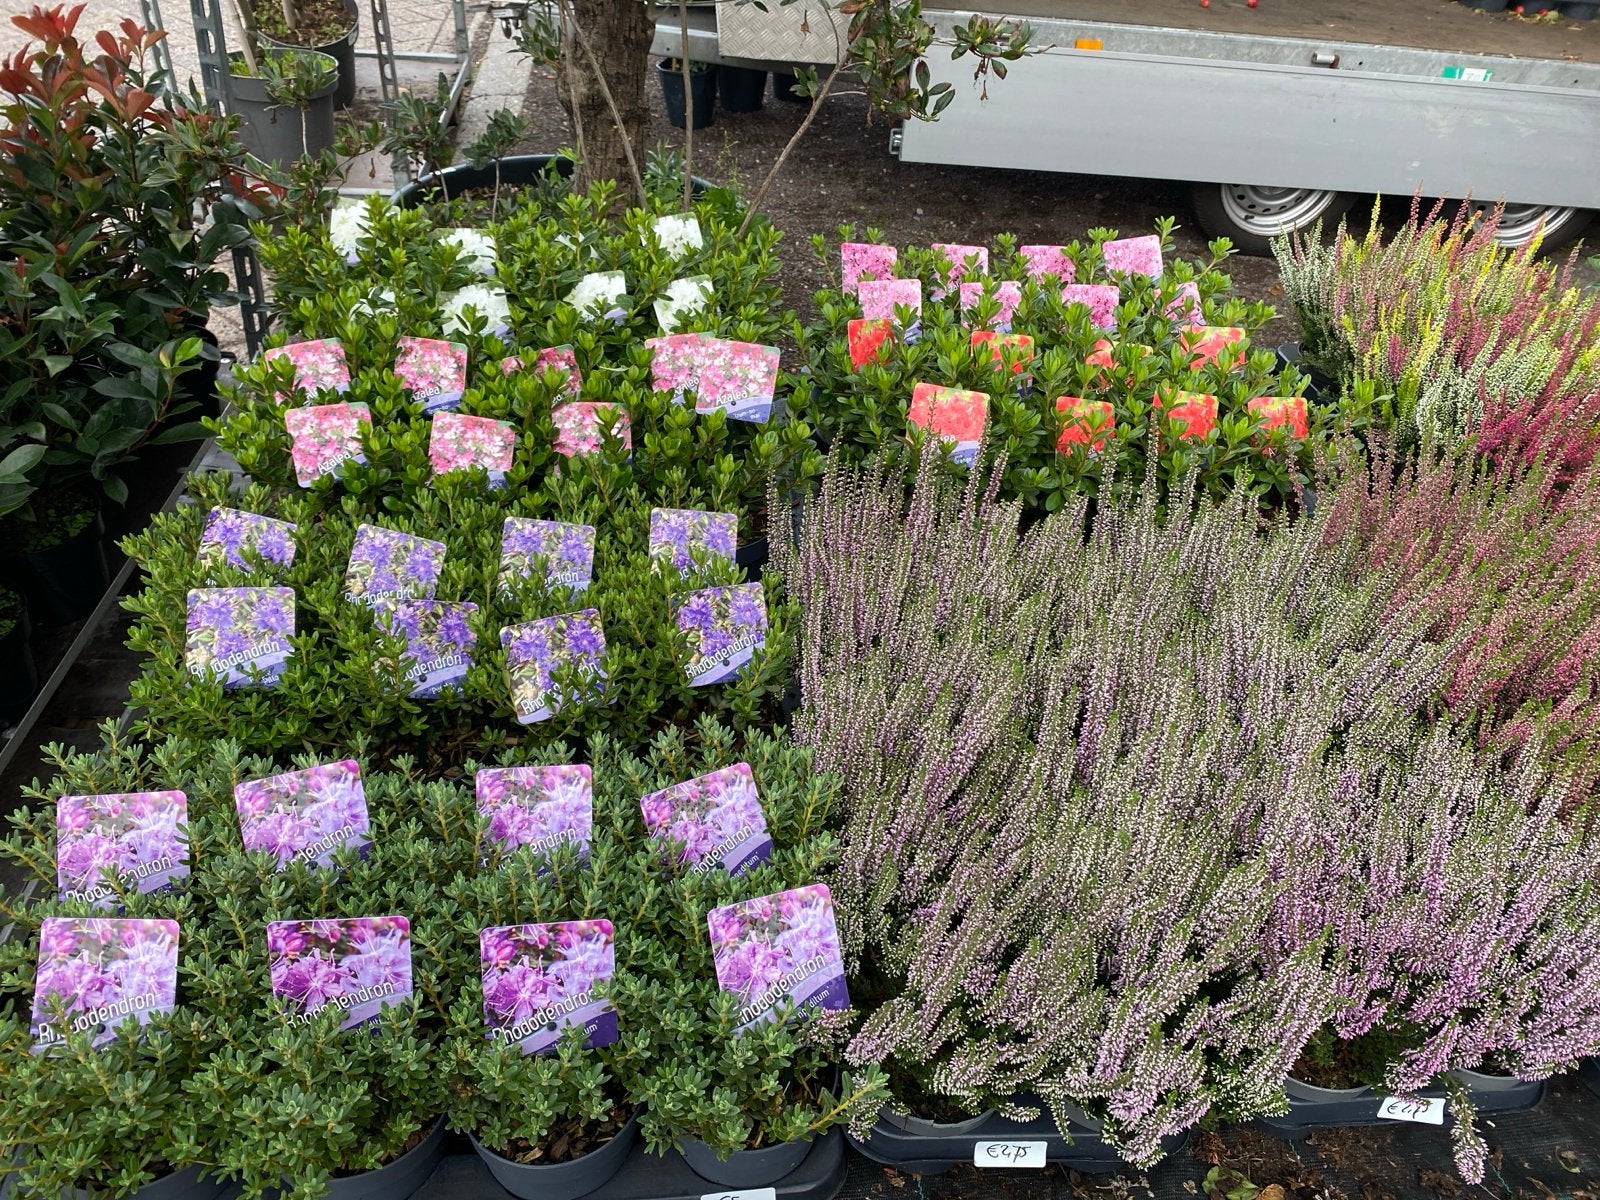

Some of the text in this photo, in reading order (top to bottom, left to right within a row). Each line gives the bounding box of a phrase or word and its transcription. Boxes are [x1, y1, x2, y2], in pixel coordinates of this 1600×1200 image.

[716, 389, 748, 405] Azalea
[317, 451, 351, 476] Azalea
[190, 641, 279, 682] Rhdodendron
[684, 633, 758, 678] Rhododendron
[693, 825, 754, 877] dodendron
[986, 1144, 1032, 1163] €2,75
